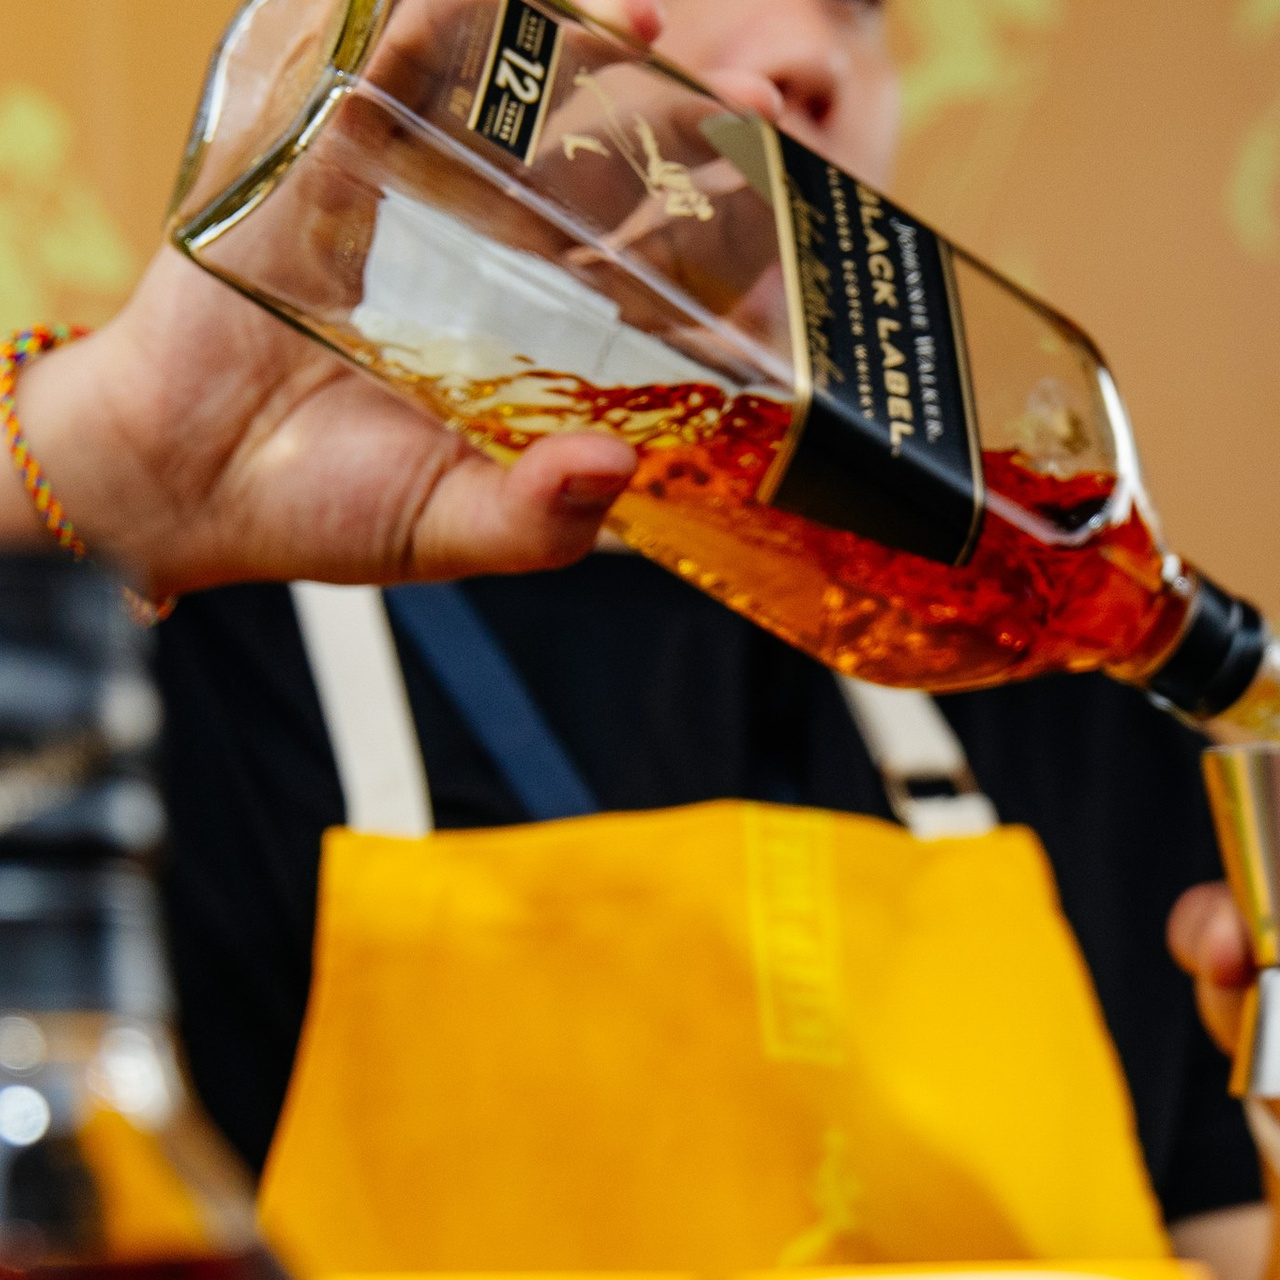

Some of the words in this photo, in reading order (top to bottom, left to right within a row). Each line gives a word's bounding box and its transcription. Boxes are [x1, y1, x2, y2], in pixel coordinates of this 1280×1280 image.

[495, 48, 545, 104] 12
[855, 182, 898, 308] BLACK
[876, 316, 915, 447] LABEL
[889, 216, 928, 330] JOHNNIE
[915, 335, 944, 443] WALKER
